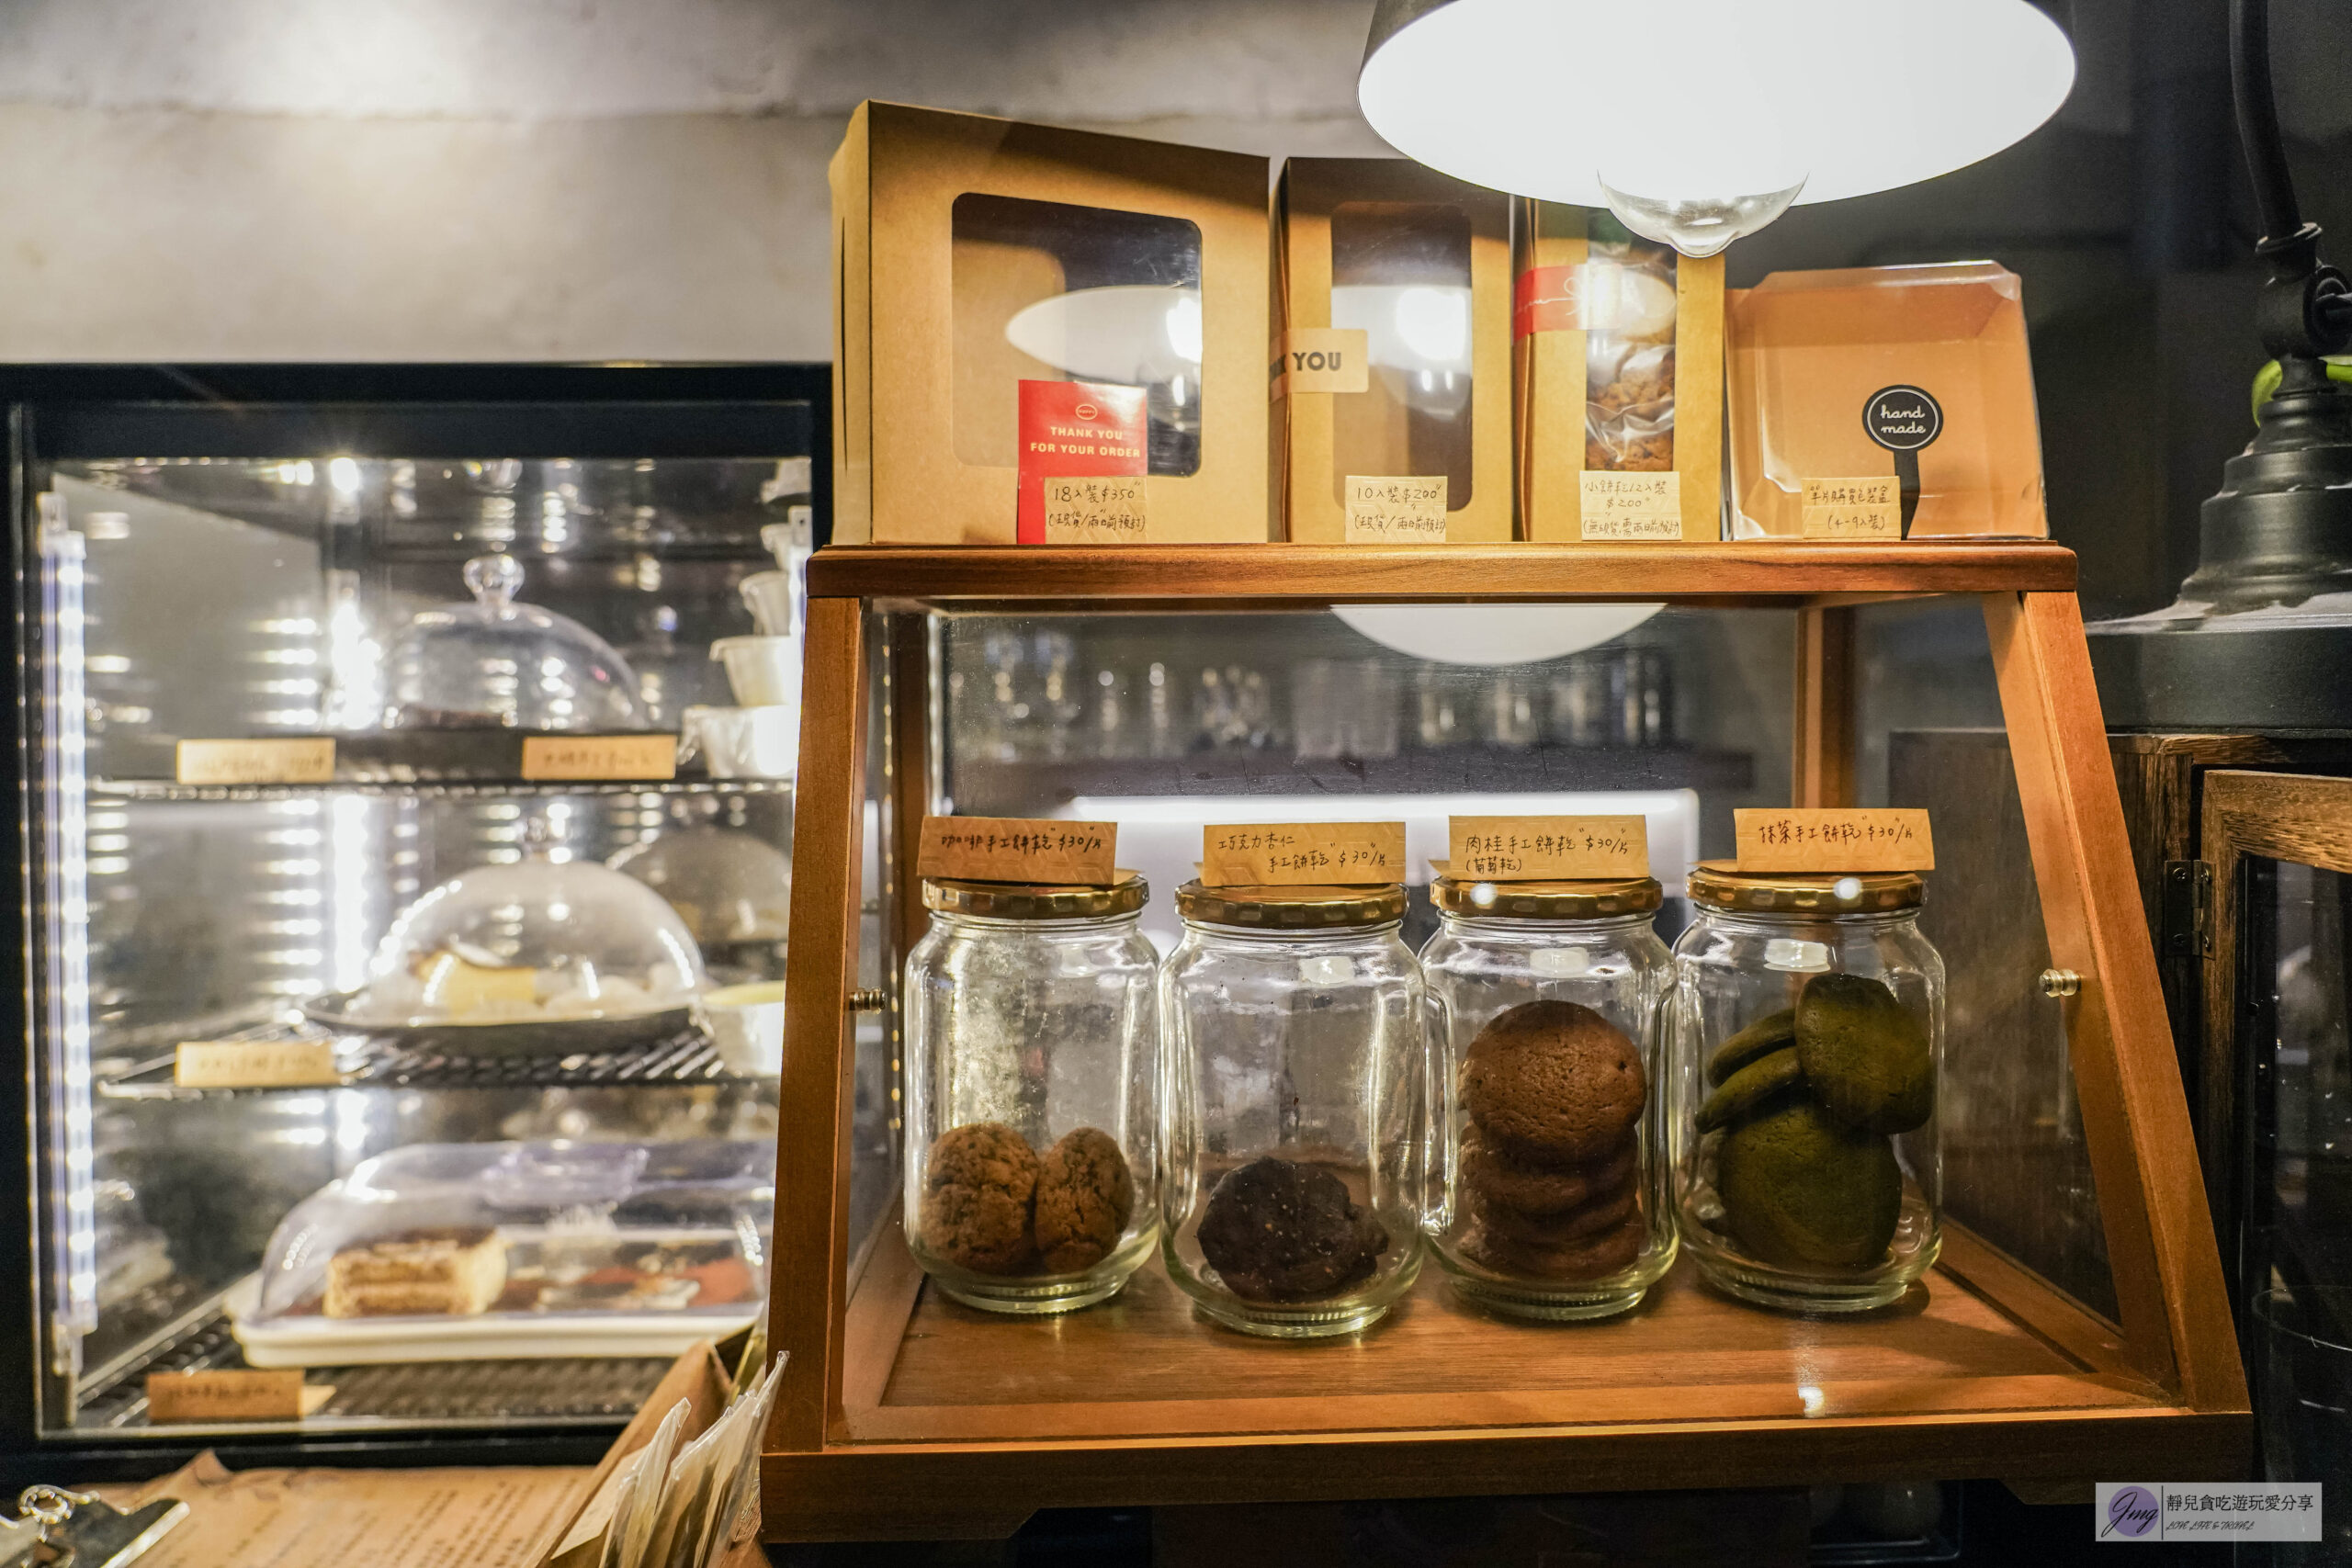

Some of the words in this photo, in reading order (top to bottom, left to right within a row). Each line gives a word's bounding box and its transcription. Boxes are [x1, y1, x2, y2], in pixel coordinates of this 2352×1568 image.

[1292, 351, 1341, 371] YOU
[1880, 404, 1926, 420] hand
[1050, 426, 1093, 438] THANK
[1097, 430, 1124, 441] YOU
[1880, 420, 1927, 434] made
[1030, 443, 1057, 453] FOR
[1060, 445, 1095, 456] YOUR
[1099, 446, 1141, 458] ORDER
[1218, 831, 1295, 851] 巧克力杏仁
